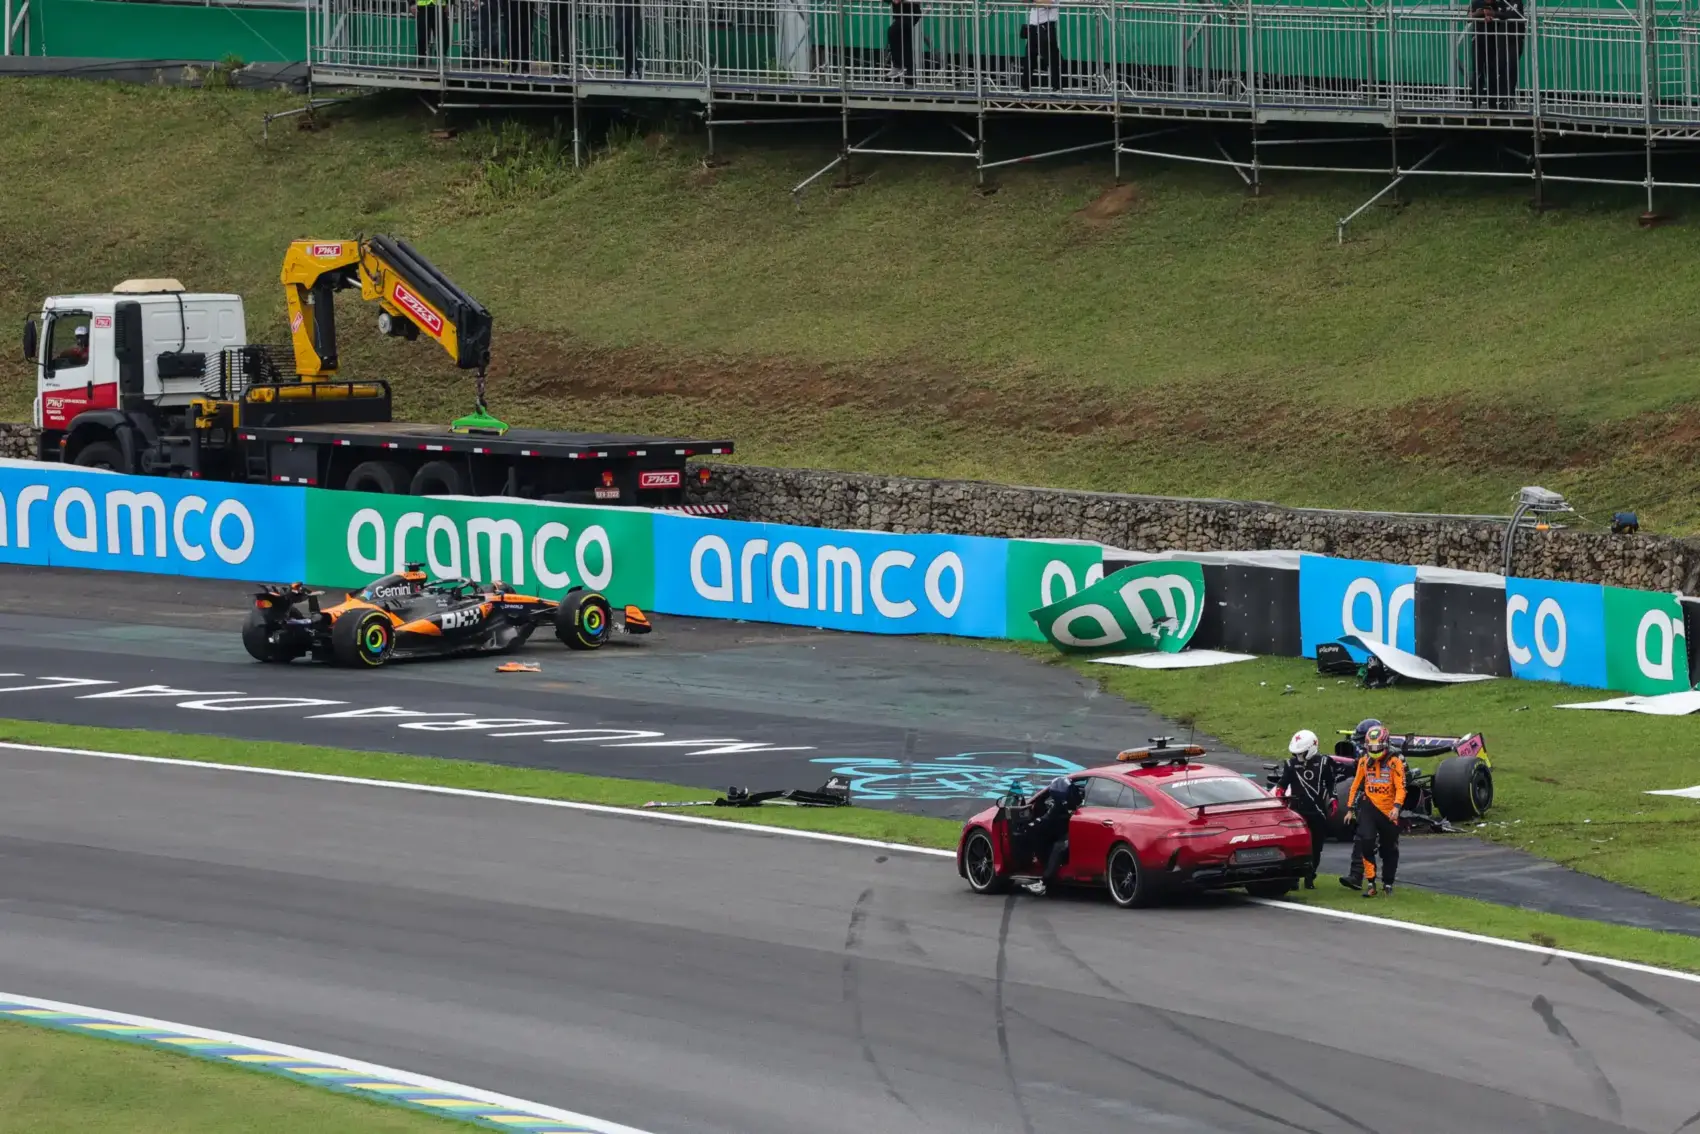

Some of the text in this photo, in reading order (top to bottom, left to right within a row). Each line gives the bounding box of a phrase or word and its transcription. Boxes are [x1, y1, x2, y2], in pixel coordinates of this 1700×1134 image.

[0, 484, 255, 565] ramco
[346, 507, 613, 590] aramco
[375, 583, 411, 598] Gemini
[689, 534, 964, 620] aramco
[1506, 593, 1567, 667] co
[0, 673, 815, 756] MUBADAL
